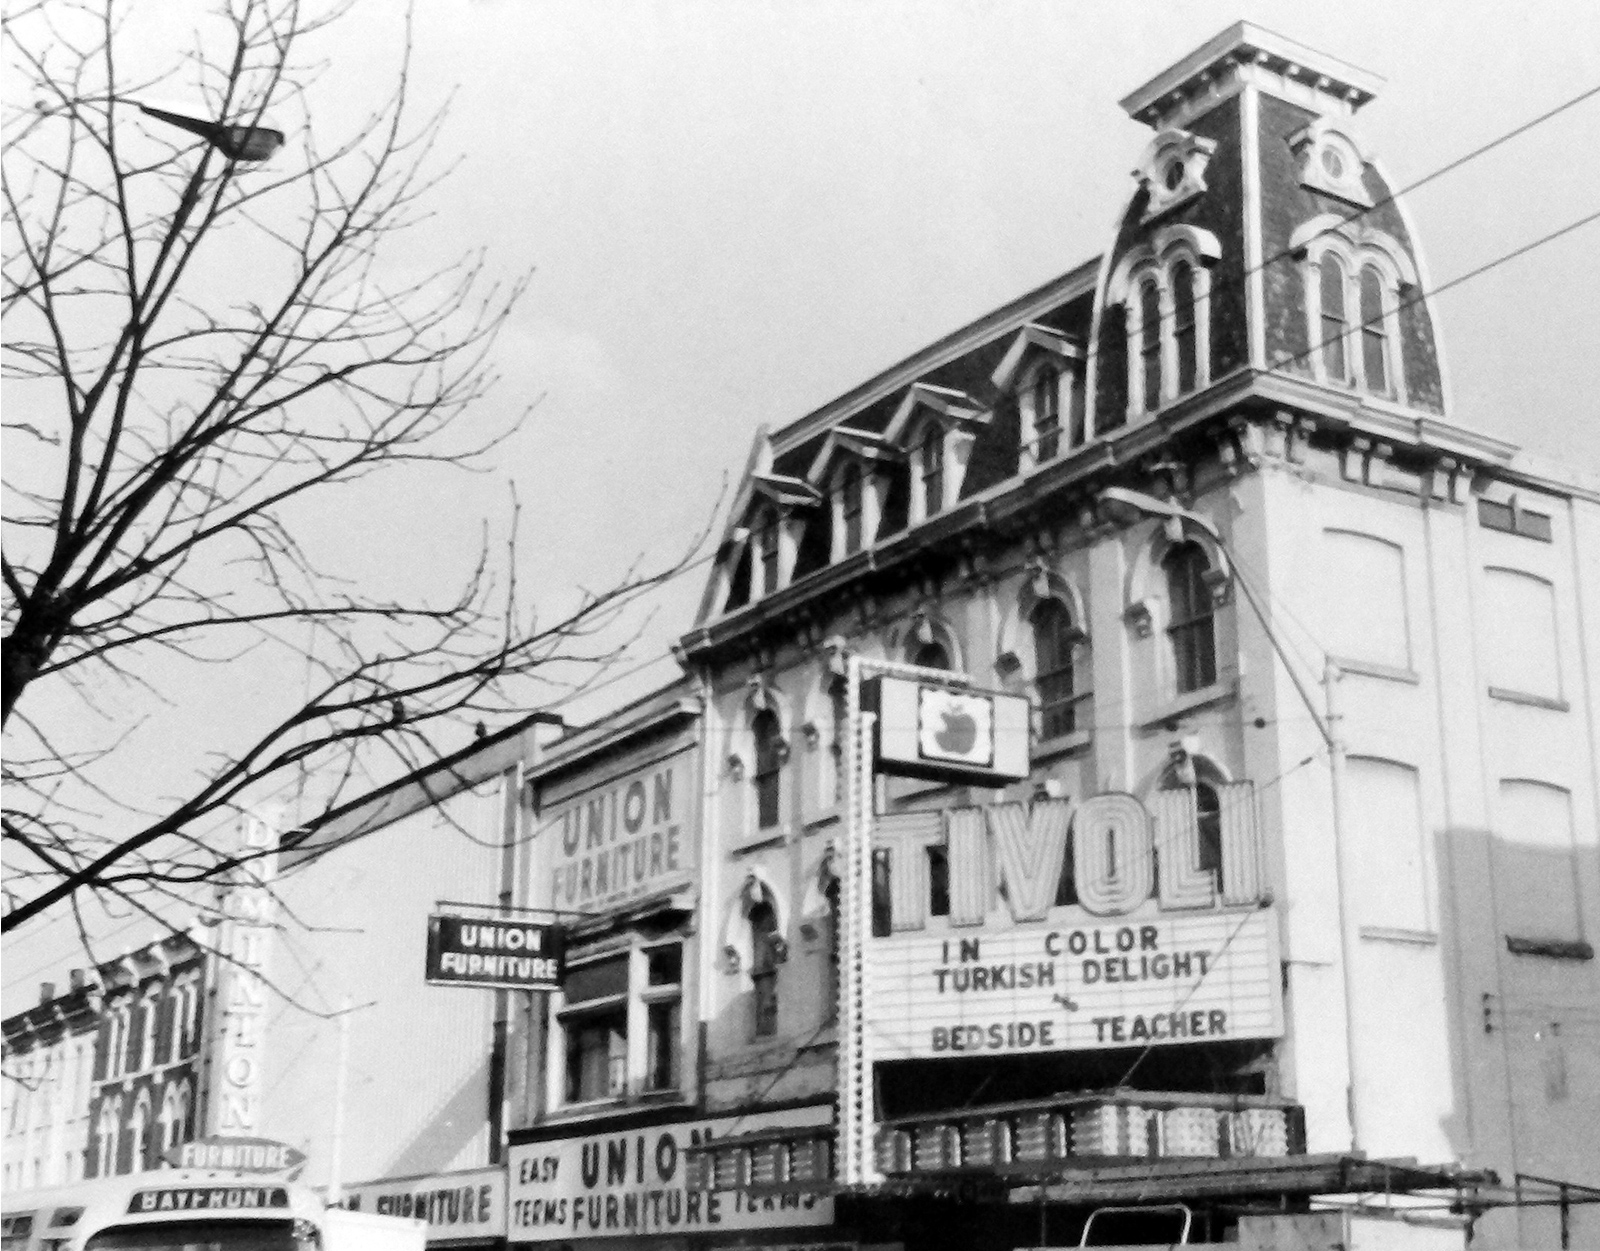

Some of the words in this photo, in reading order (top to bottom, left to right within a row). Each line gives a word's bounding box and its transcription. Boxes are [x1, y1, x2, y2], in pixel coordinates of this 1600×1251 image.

[563, 768, 673, 857] UNION
[551, 824, 680, 908] FURNITURE
[872, 779, 1259, 932] TIVOLI
[460, 924, 542, 951] UNION
[941, 938, 980, 963] IN
[1044, 925, 1159, 956] COLOR
[440, 952, 559, 980] FURNITURE
[932, 962, 1055, 993] TURKISH
[1082, 949, 1212, 984] DELIGHT
[931, 1020, 1055, 1052] BEDSIDE
[1092, 1008, 1227, 1043] TEACHER
[181, 1142, 288, 1168] FURNITURE
[519, 1156, 561, 1186] EASY
[513, 1197, 568, 1227] TERMS
[572, 1190, 722, 1232] FURNITURE
